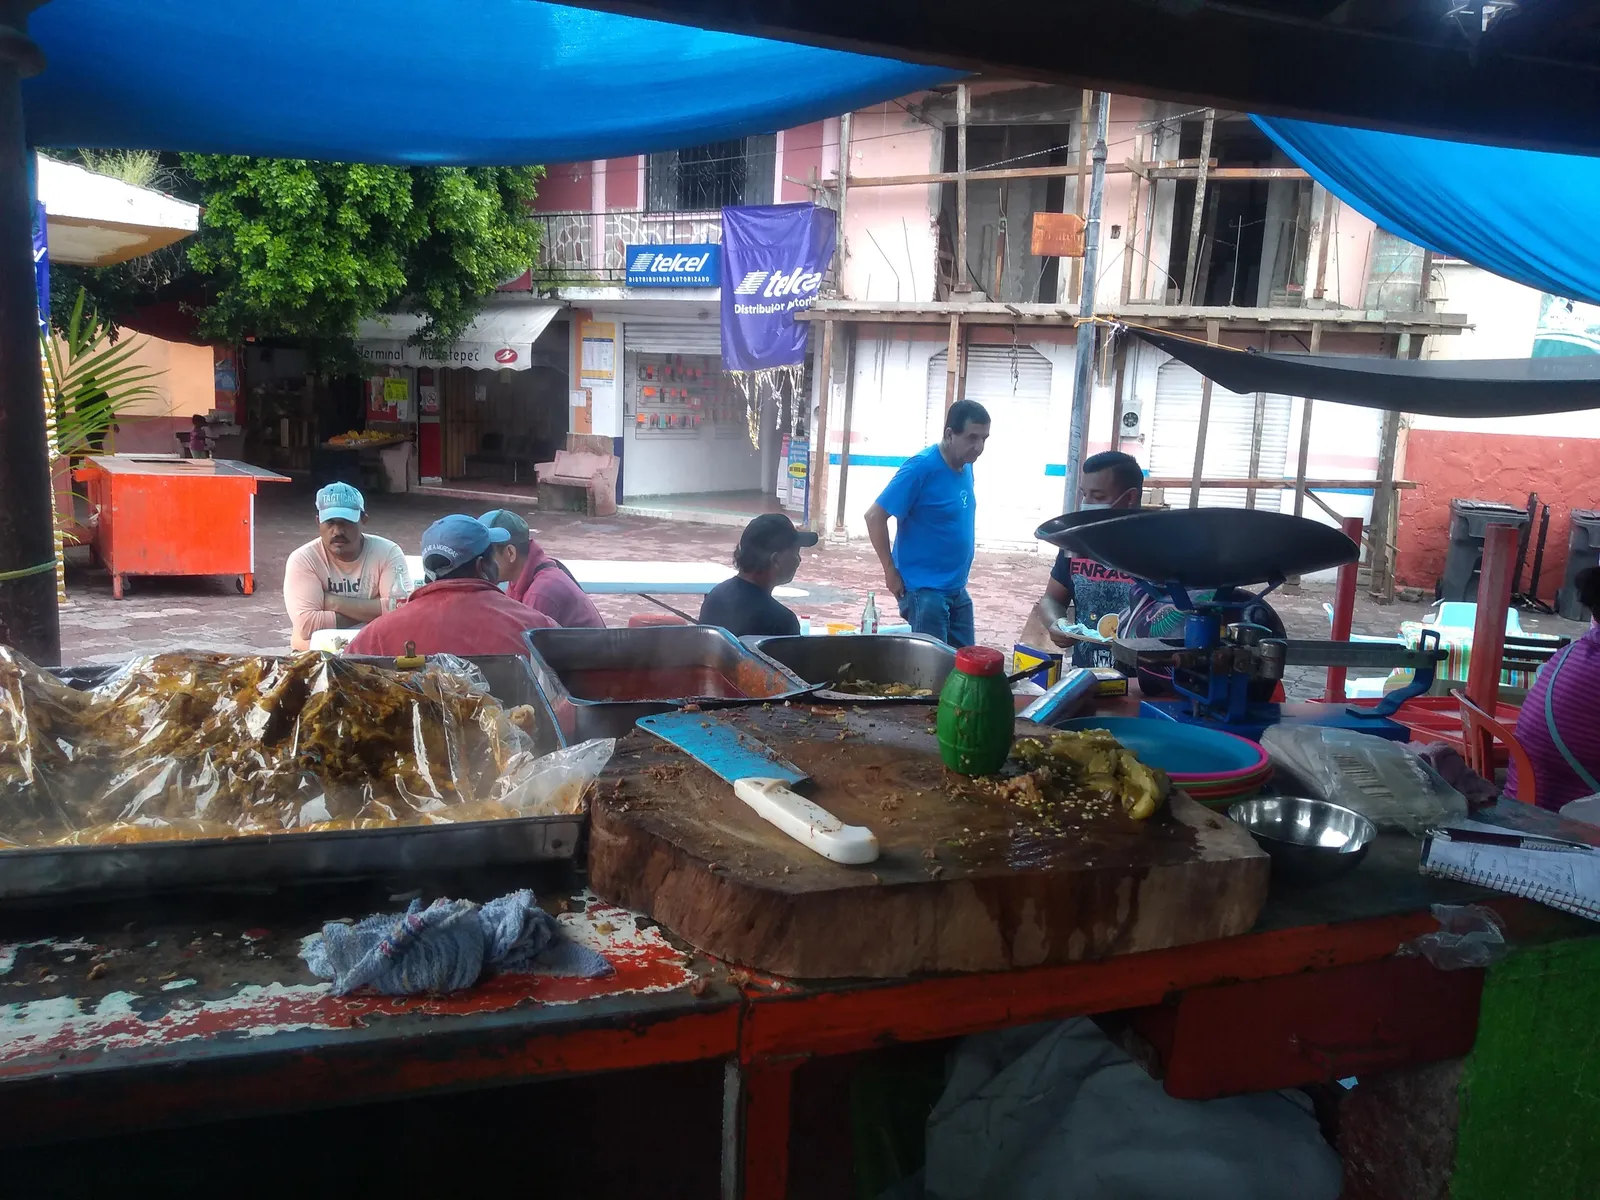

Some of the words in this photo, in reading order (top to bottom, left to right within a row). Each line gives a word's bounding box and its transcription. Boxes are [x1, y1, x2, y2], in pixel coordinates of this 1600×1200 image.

[650, 252, 710, 272] telcel
[357, 345, 404, 360] Terminal
[419, 347, 480, 364] Matepec
